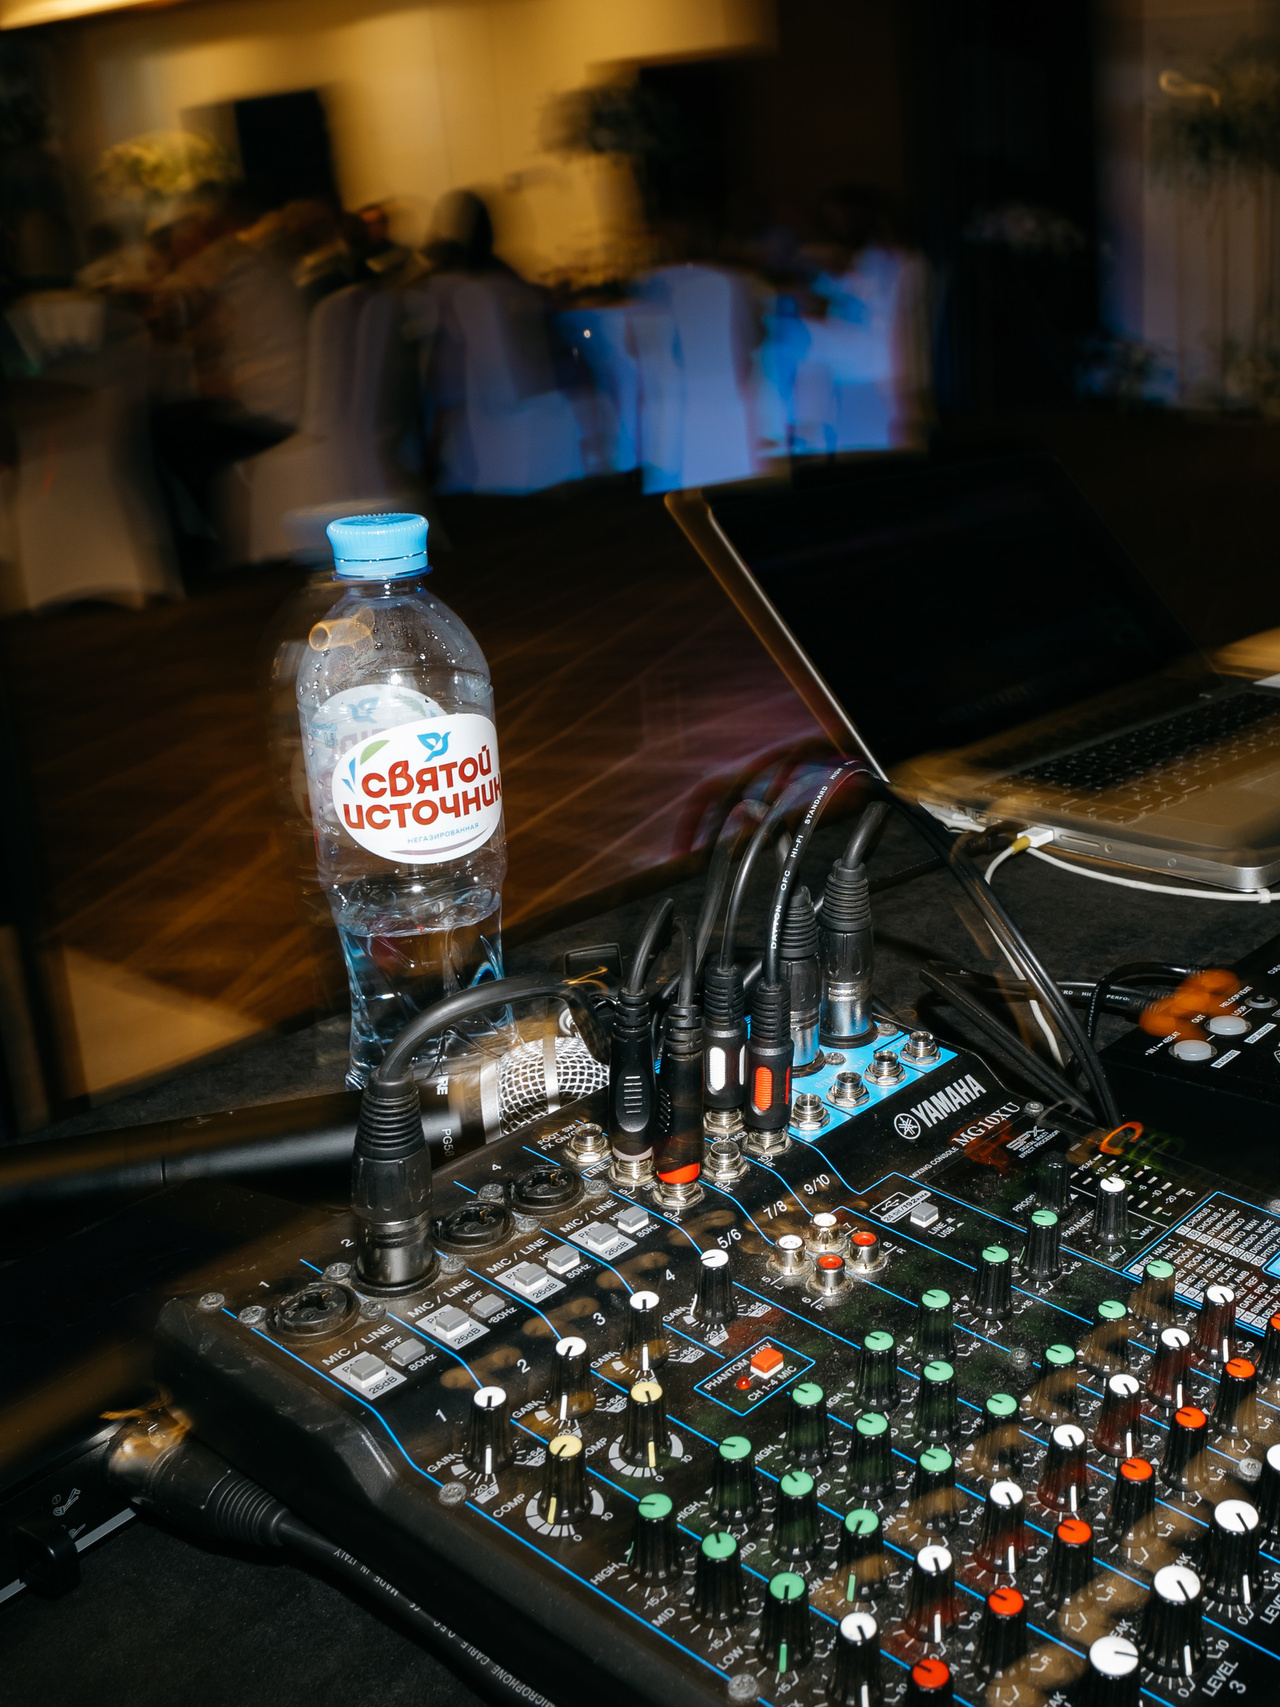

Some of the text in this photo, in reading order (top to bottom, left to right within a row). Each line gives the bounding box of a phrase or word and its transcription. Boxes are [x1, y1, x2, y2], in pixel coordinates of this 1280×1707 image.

[407, 822, 479, 844] НЕГАЗИРОВАННАЯ
[781, 870, 790, 891] OFC
[805, 785, 828, 824] STANDARD
[1191, 1014, 1206, 1023] OUT
[1232, 1006, 1247, 1016] LOOP
[910, 1074, 987, 1127] YAMAHA
[442, 1128, 454, 1156] PG58
[537, 1132, 558, 1145] FOOT
[541, 1142, 555, 1150] FX
[909, 1101, 1020, 1179] MIXING CONSOLE MG10XU
[584, 1162, 610, 1178] LINE
[1079, 1160, 1094, 1172] PEAK
[803, 1174, 830, 1195] 9/10
[559, 1200, 617, 1233] MIC LINE
[763, 1201, 788, 1220] 7/8
[1186, 1208, 1211, 1227] CHORUS
[636, 1223, 660, 1238] 80Hz
[928, 1221, 947, 1234] LINE
[1196, 1212, 1222, 1232] CHORUS
[1207, 1209, 1240, 1235] SYMPHONIC
[1217, 1218, 1245, 1240] TREMOLO
[717, 1228, 742, 1250] 5/6
[937, 1227, 955, 1237] USB
[1140, 1225, 1155, 1238] MAX
[1229, 1219, 1259, 1245] AUTO WAH
[1239, 1219, 1275, 1249] RADIO VOICE
[341, 1238, 354, 1247] 2
[605, 1240, 629, 1256] 26dB
[1261, 1244, 1279, 1259] PITCH
[486, 1238, 549, 1274] MIC LINE
[1140, 1243, 1170, 1266] REV HALL
[1163, 1247, 1181, 1260] HALL
[1174, 1248, 1195, 1265] ROOM
[1185, 1252, 1205, 1269] ROOM
[567, 1263, 592, 1280] 80Hz
[665, 1269, 675, 1282] 4
[1183, 1257, 1216, 1285] REV STAGE
[1194, 1262, 1227, 1290] REV STAGE
[1217, 1268, 1238, 1283] PLATE
[1234, 1271, 1250, 1284] AMB
[532, 1281, 557, 1298] 26dB
[1245, 1275, 1259, 1288] REF
[407, 1279, 474, 1319] MIC LINE
[462, 1290, 483, 1305] HPF
[1240, 1282, 1269, 1308] GATE REV
[1251, 1295, 1273, 1314] SINGLE
[490, 1305, 517, 1323] 80Hz
[593, 1313, 605, 1325] 3
[662, 1307, 685, 1322] GAIN
[381, 1336, 403, 1352] HPF
[454, 1326, 481, 1345] 26dB
[321, 1324, 394, 1367] MIC LINE
[408, 1353, 437, 1372] 80Hz
[516, 1359, 530, 1373] 2
[590, 1351, 615, 1370] GAIN
[703, 1359, 749, 1391] PHANTOM
[747, 1366, 797, 1401] CH 1-4 MIC
[368, 1375, 398, 1394] 26dB
[435, 1409, 448, 1422] 1
[511, 1400, 538, 1420] GAIN
[426, 1454, 456, 1474] GAIN
[681, 1454, 692, 1463] 10
[469, 1484, 488, 1497] +20
[493, 1494, 526, 1519] COMP
[601, 1512, 613, 1521] 10
[591, 1563, 620, 1585] HIGH
[652, 1608, 676, 1627] MID
[1237, 1616, 1248, 1625] 0
[1214, 1639, 1229, 1654] 10
[717, 1646, 744, 1670] LOW
[1202, 1660, 1238, 1697] LEVEL
[1229, 1681, 1246, 1694] 3
[1177, 1688, 1189, 1698] 0
